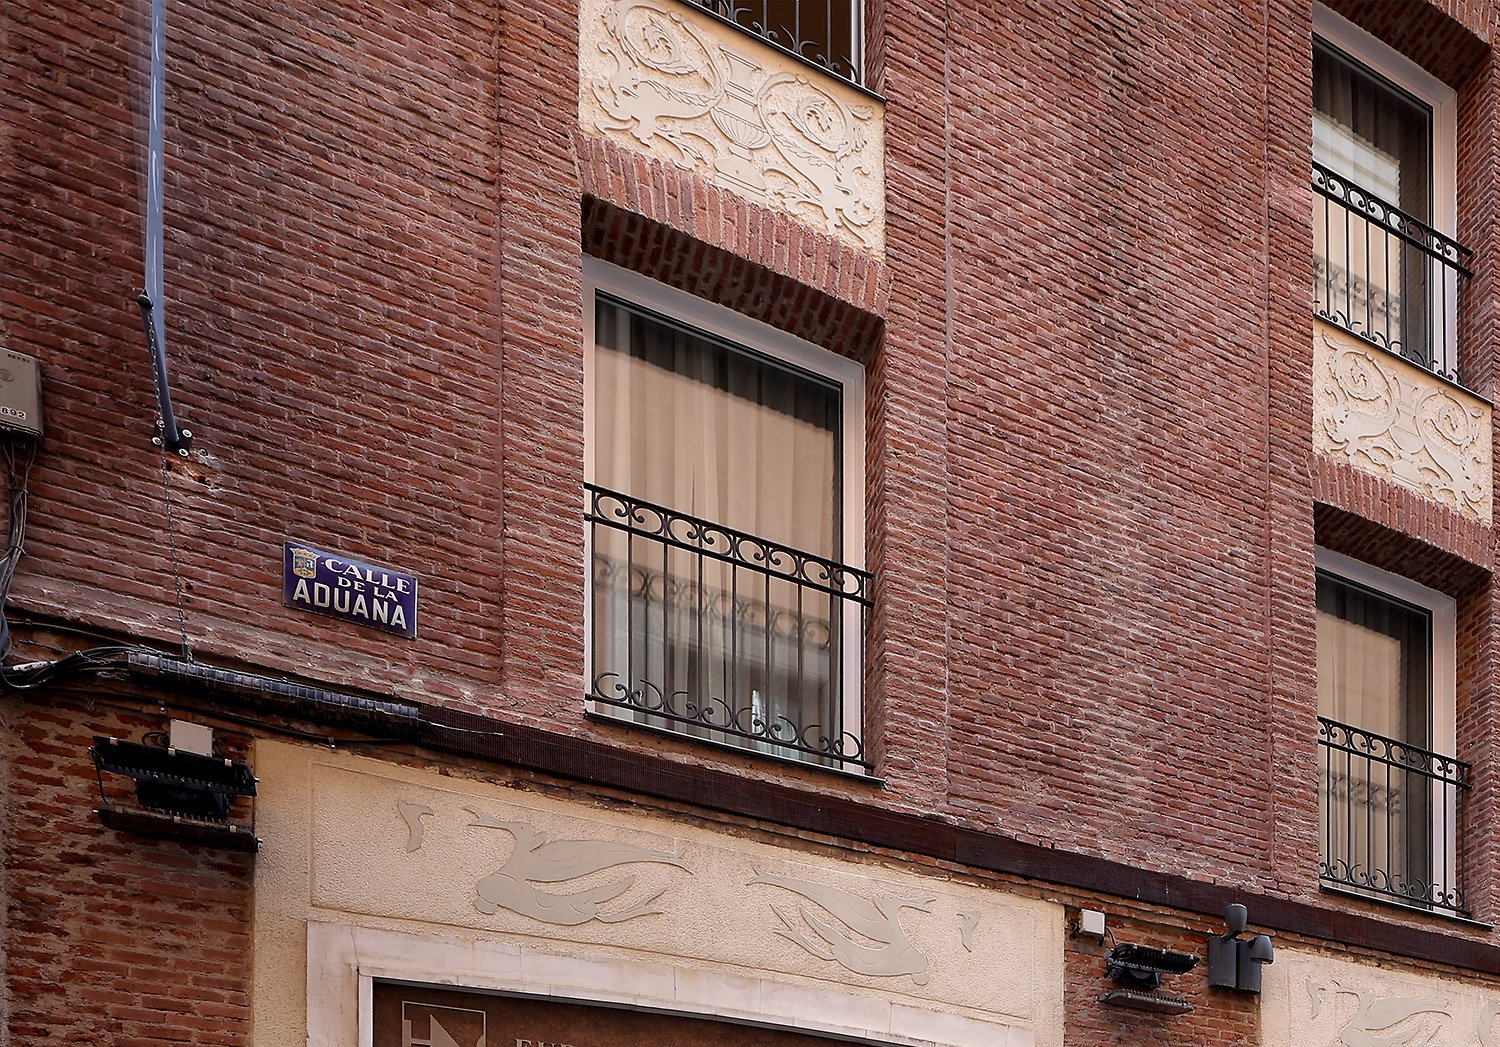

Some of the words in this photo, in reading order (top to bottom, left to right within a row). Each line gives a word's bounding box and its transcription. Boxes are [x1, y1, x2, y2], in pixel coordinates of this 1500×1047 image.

[325, 558, 411, 595] CALLE
[337, 576, 366, 592] DE
[373, 586, 398, 602] LA
[292, 578, 407, 630] ADUANA
